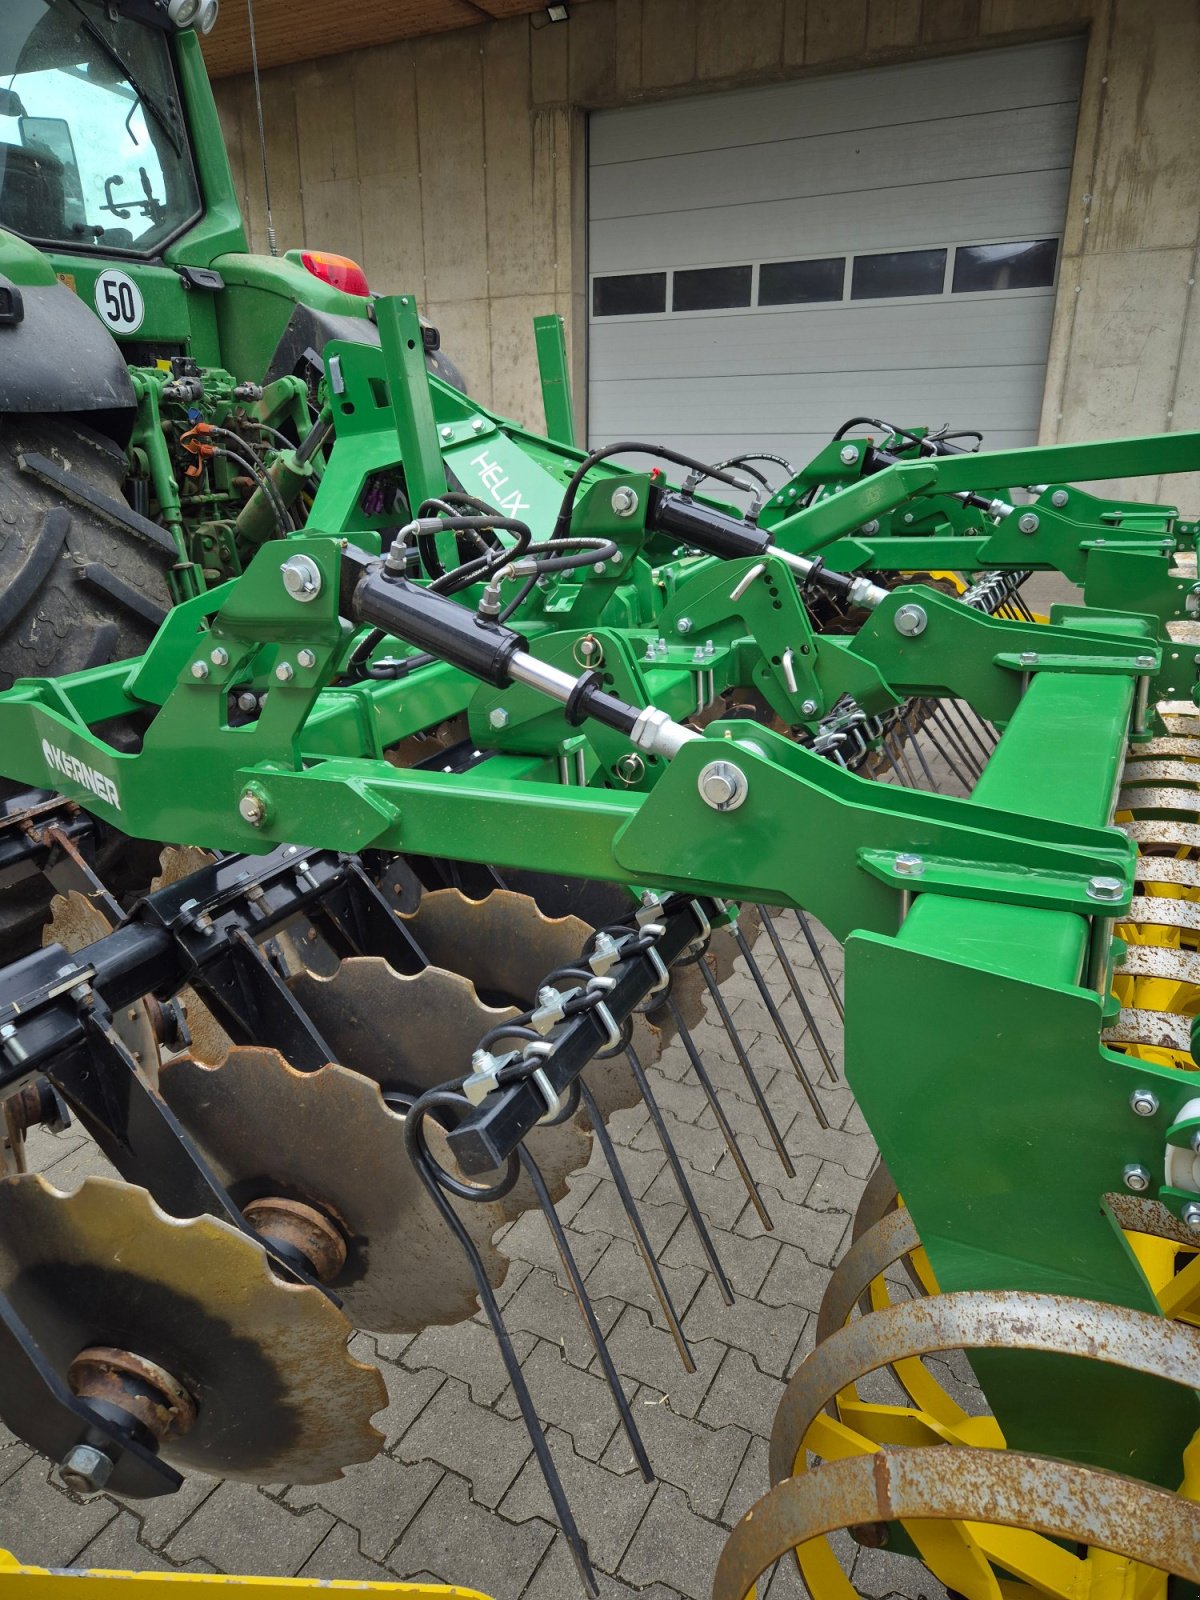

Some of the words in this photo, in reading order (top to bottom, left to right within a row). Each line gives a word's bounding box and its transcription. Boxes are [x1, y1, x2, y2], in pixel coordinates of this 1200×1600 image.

[103, 281, 135, 323] 50
[470, 450, 530, 519] HELIX
[50, 743, 121, 811] KERNER
